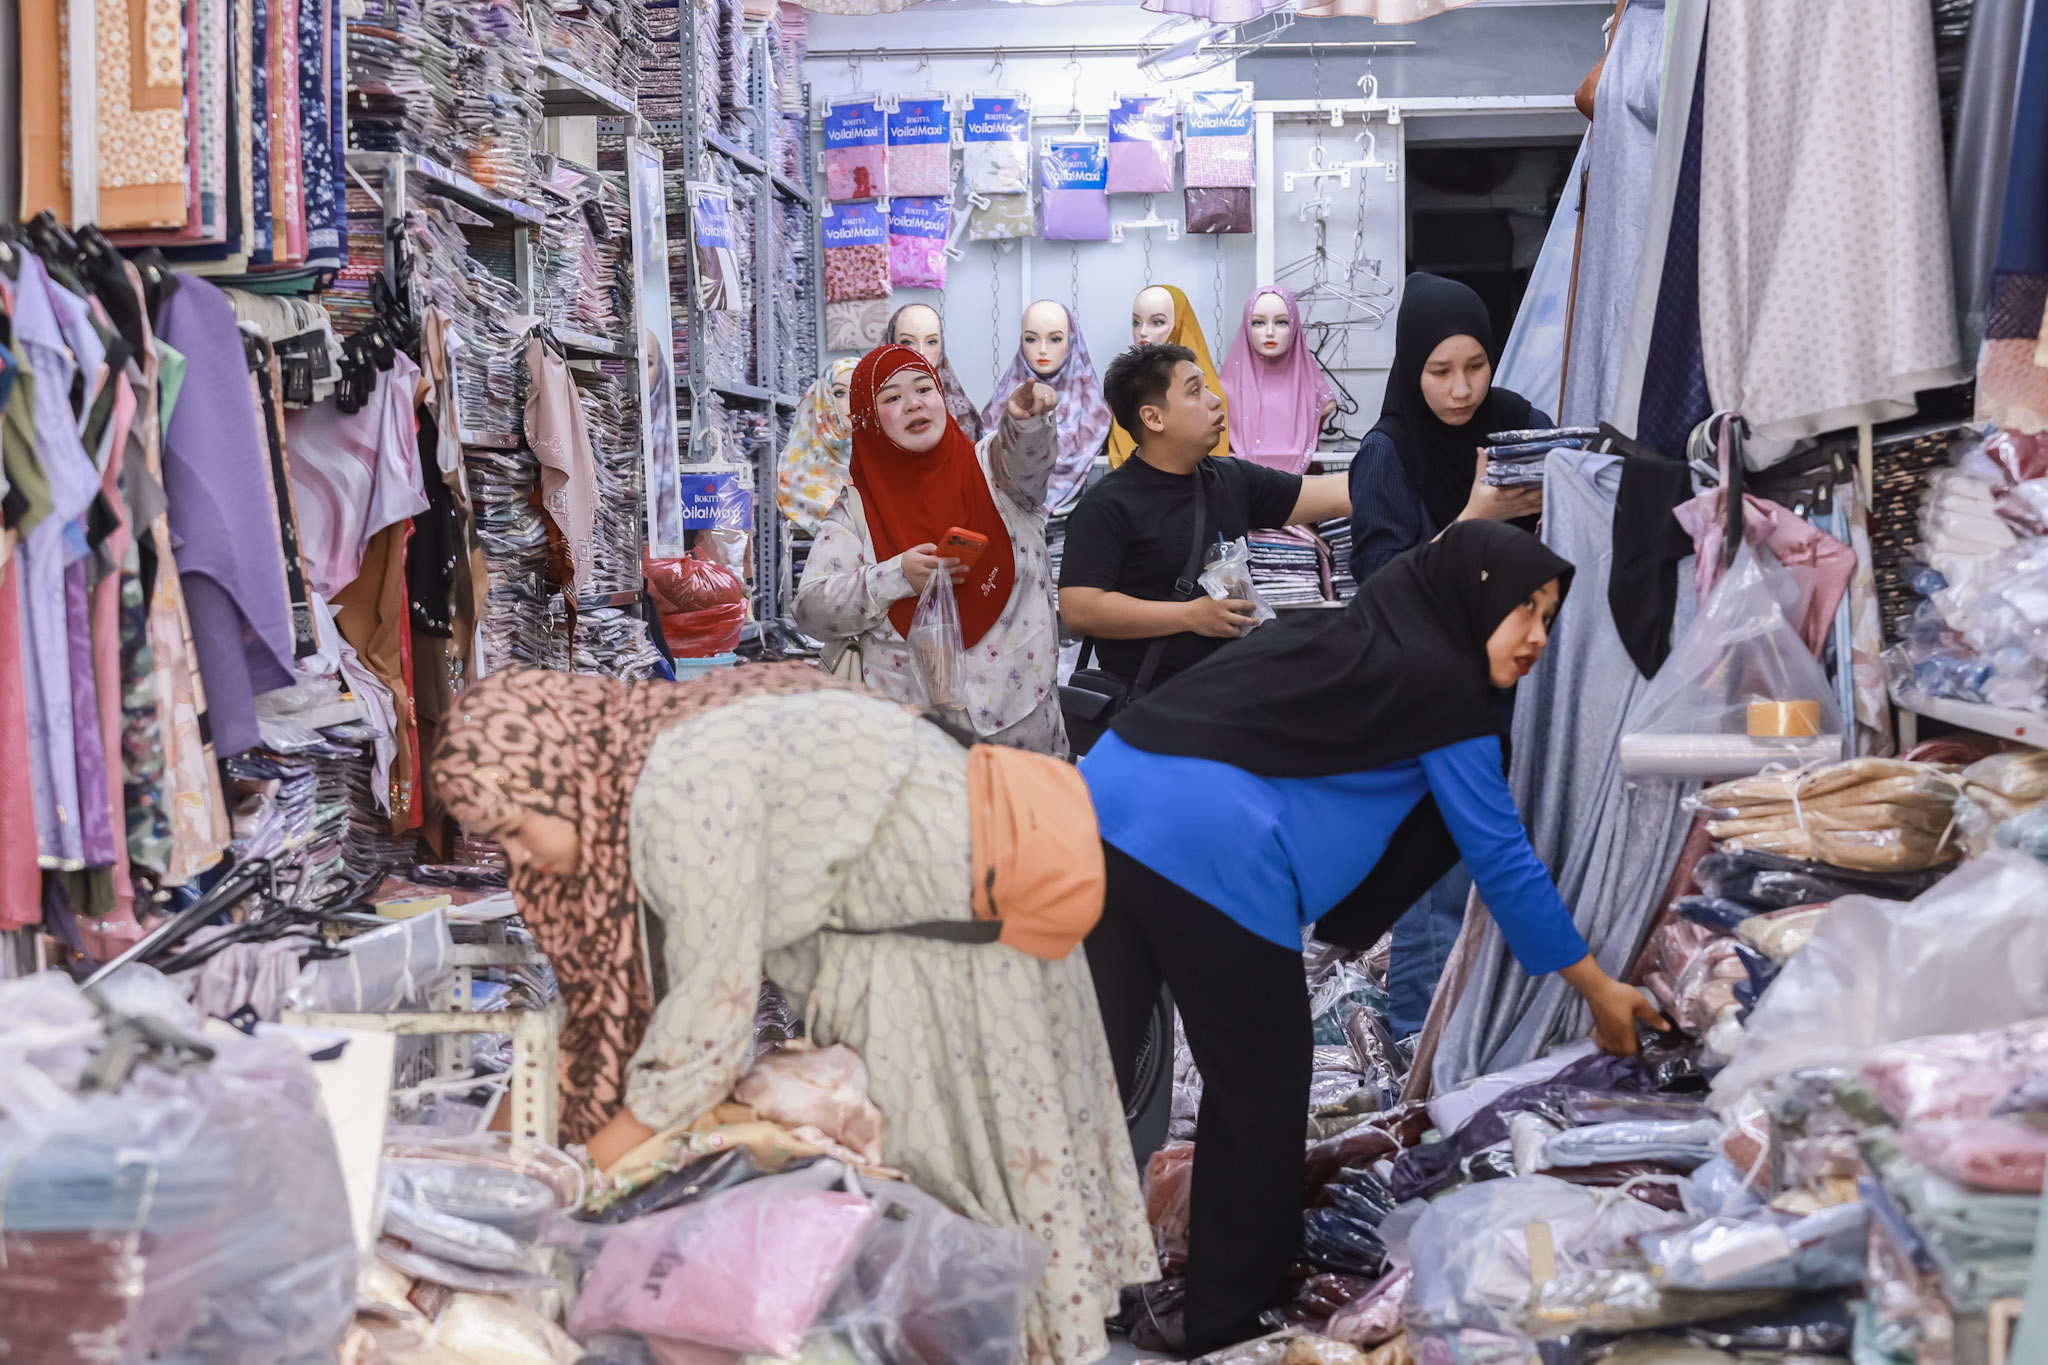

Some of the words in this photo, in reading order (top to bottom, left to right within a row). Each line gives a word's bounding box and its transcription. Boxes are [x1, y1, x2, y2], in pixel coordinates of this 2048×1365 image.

[843, 118, 866, 127] BOKITTA
[906, 116, 930, 124] BOKITTA
[828, 126, 879, 140] Voila!Maxi
[891, 124, 943, 138] Voila!Maxi
[904, 207, 929, 216] BOKITTA
[841, 217, 866, 226] BOKITTA
[826, 226, 879, 240] Voila!Maxi
[682, 505, 741, 519] oila!Maxi
